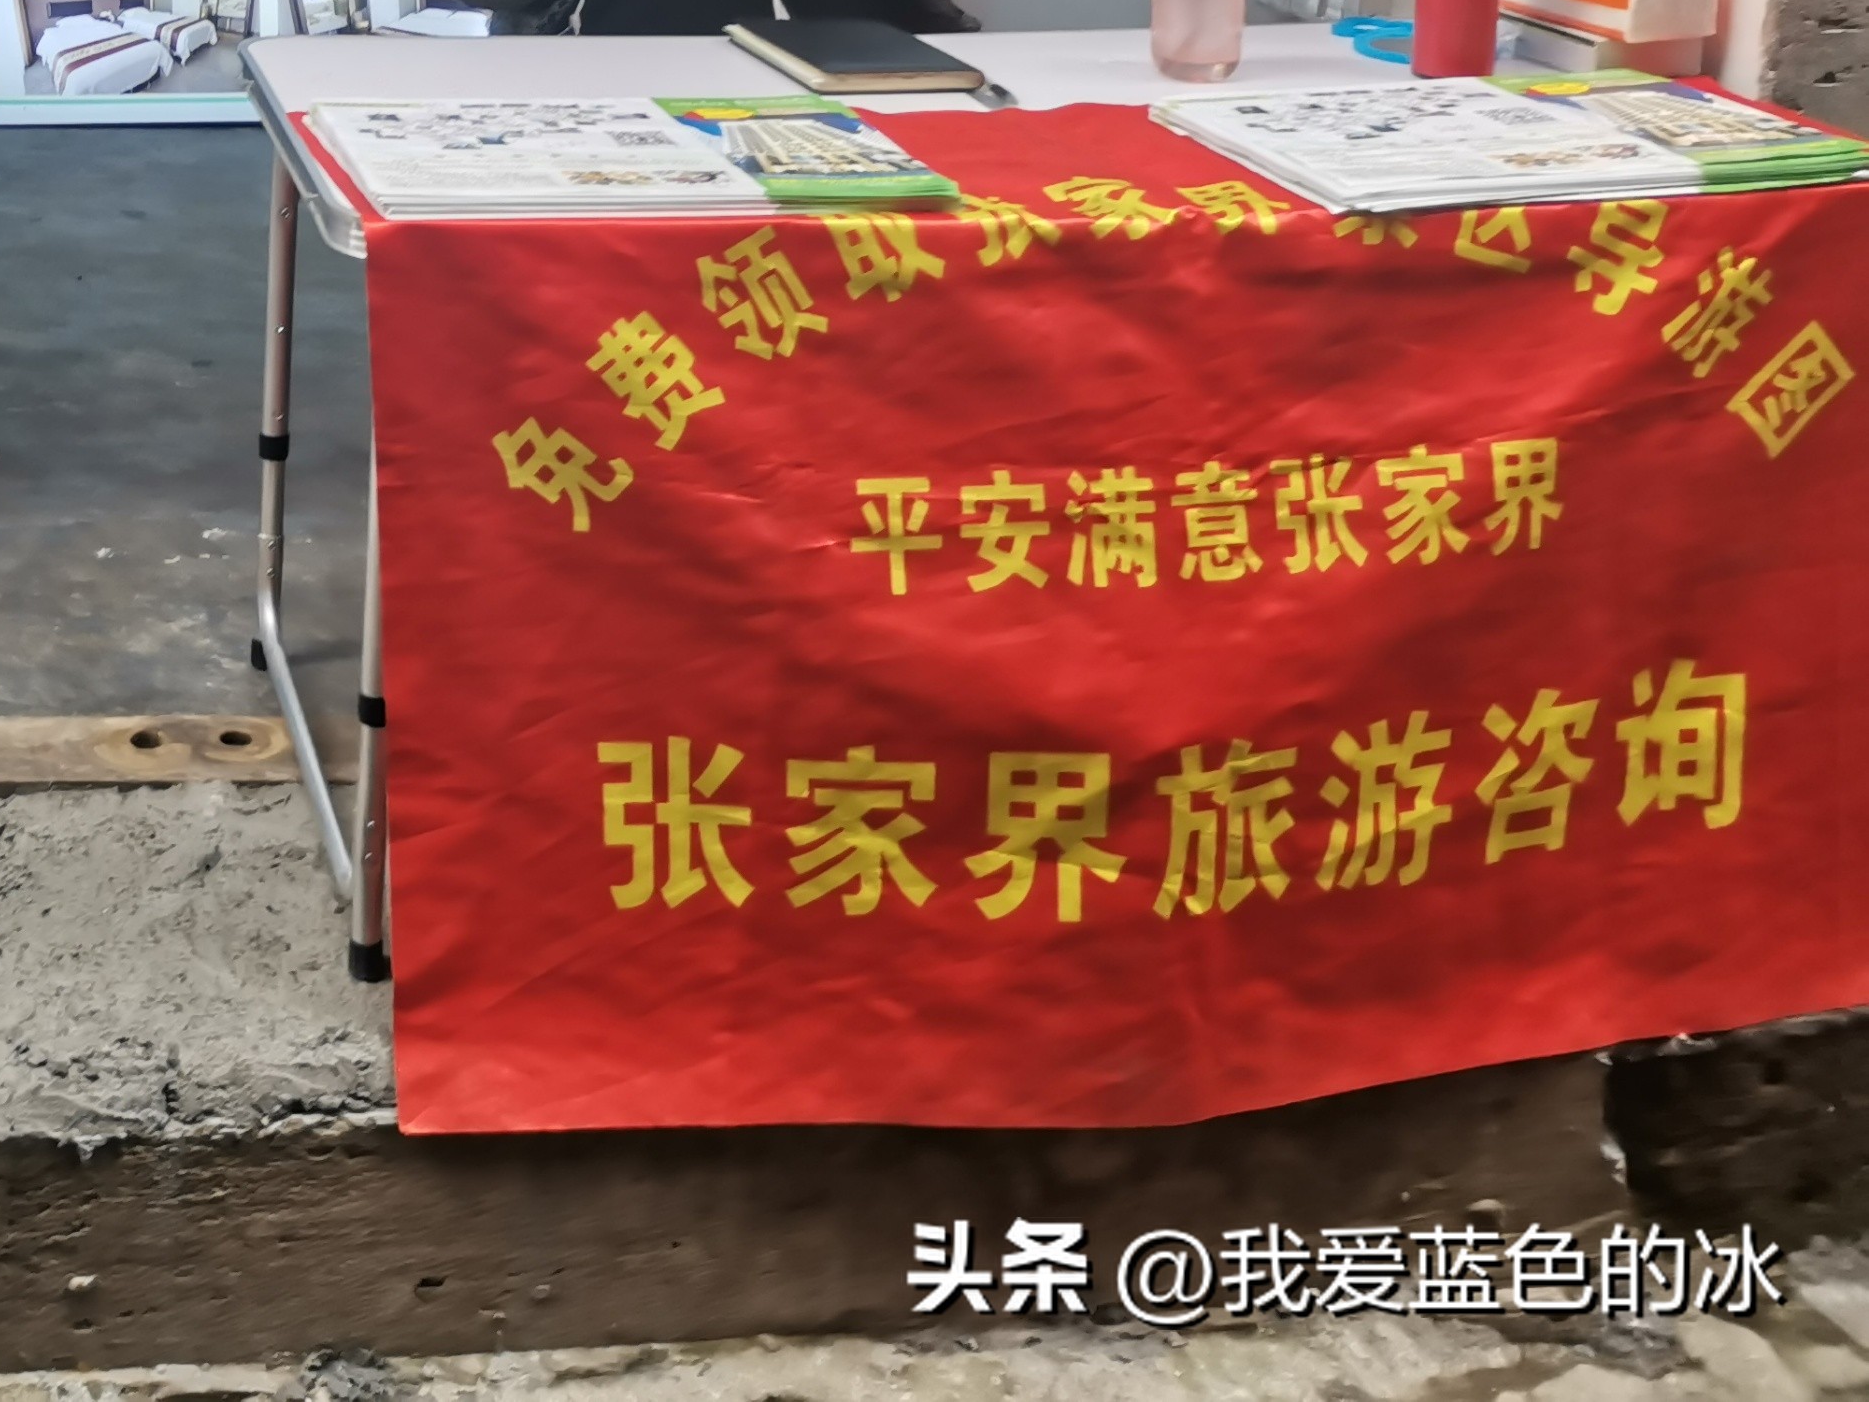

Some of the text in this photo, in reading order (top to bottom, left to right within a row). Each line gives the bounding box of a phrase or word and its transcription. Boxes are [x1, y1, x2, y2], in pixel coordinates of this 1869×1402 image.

[850, 437, 1563, 595] 平安满意张家界
[597, 659, 1747, 922] 张家界旅游咨询
